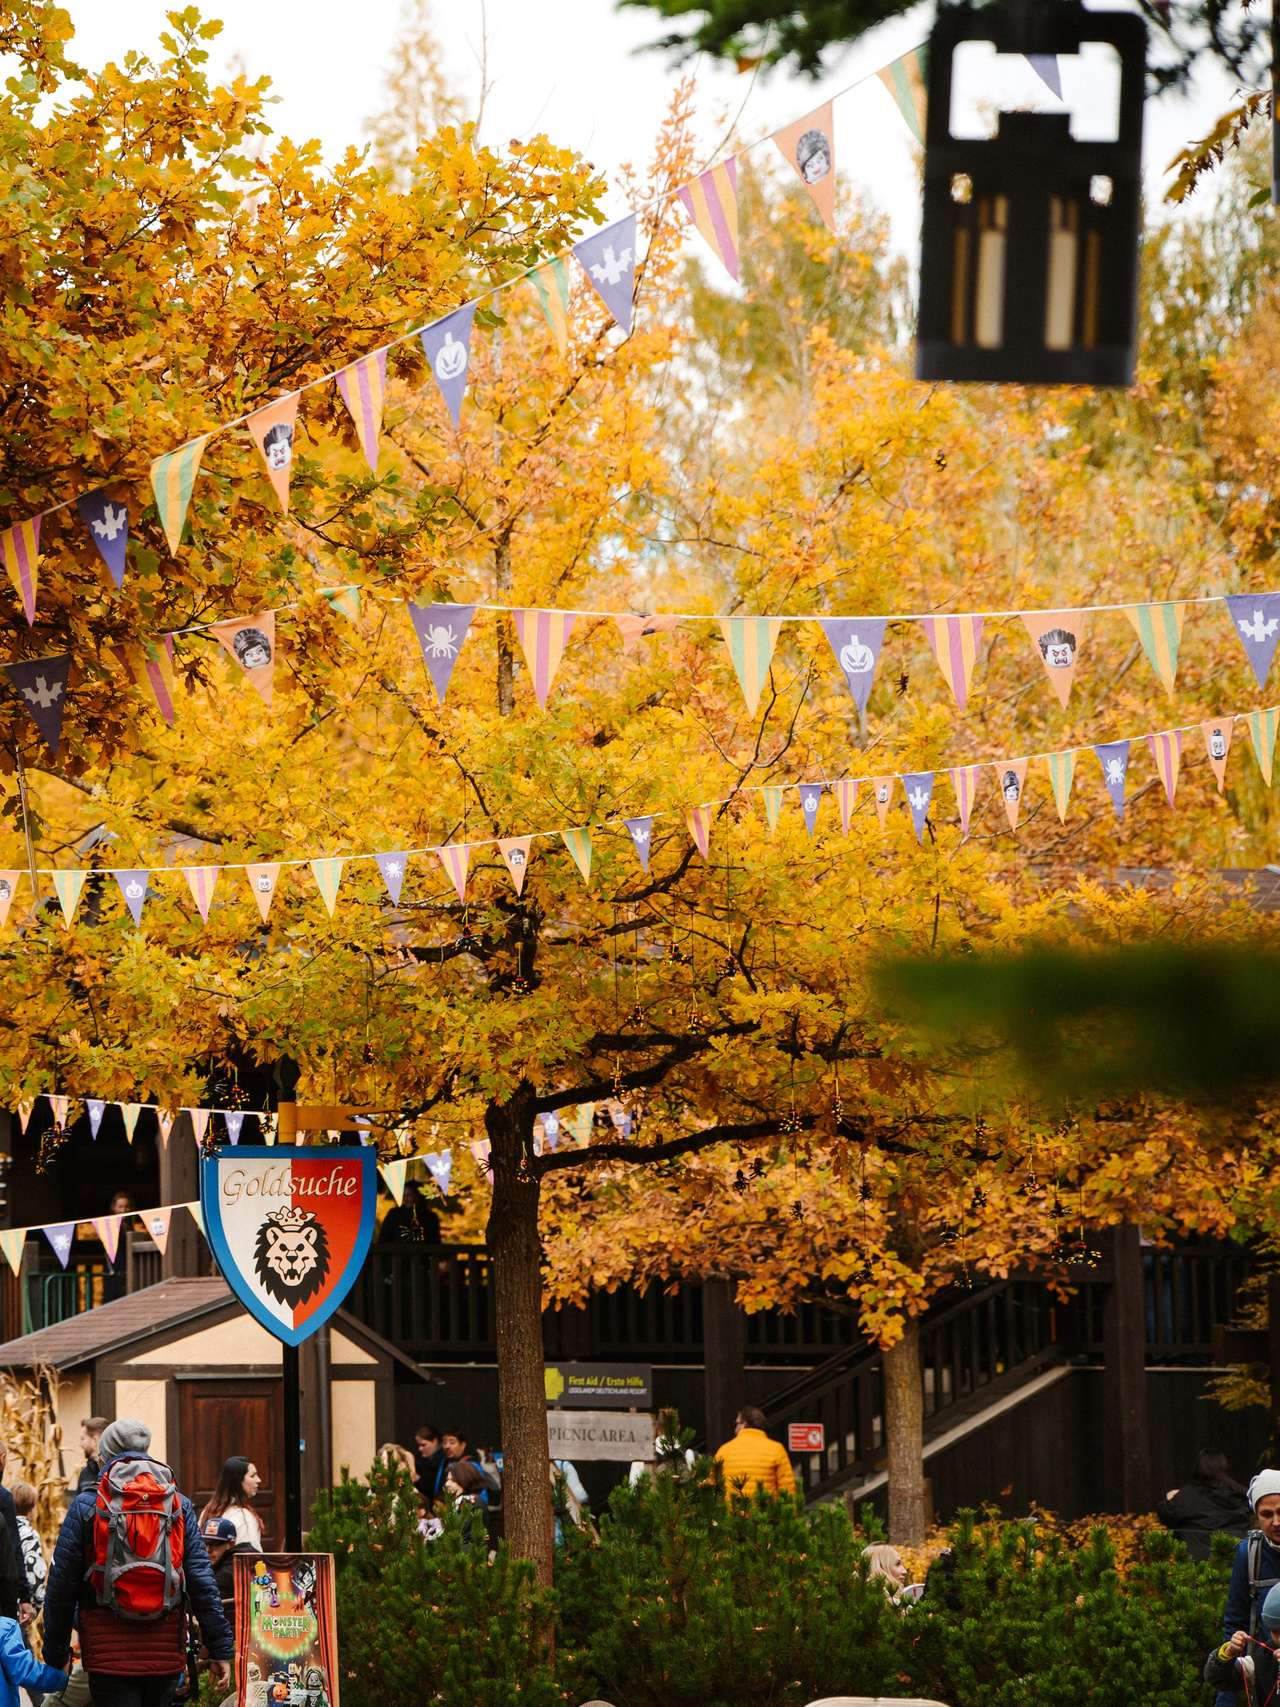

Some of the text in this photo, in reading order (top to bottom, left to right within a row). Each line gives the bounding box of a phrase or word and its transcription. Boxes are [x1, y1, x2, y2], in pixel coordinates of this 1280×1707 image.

[223, 1165, 357, 1206] Goldsuche
[569, 1376, 585, 1386] First
[586, 1376, 598, 1386] Aid
[606, 1376, 625, 1387] Erste
[626, 1376, 644, 1387] Hilfe
[548, 1427, 636, 1443] PICNIC AREA
[261, 1614, 309, 1632] MONSTER
[272, 1626, 302, 1639] PARTY
